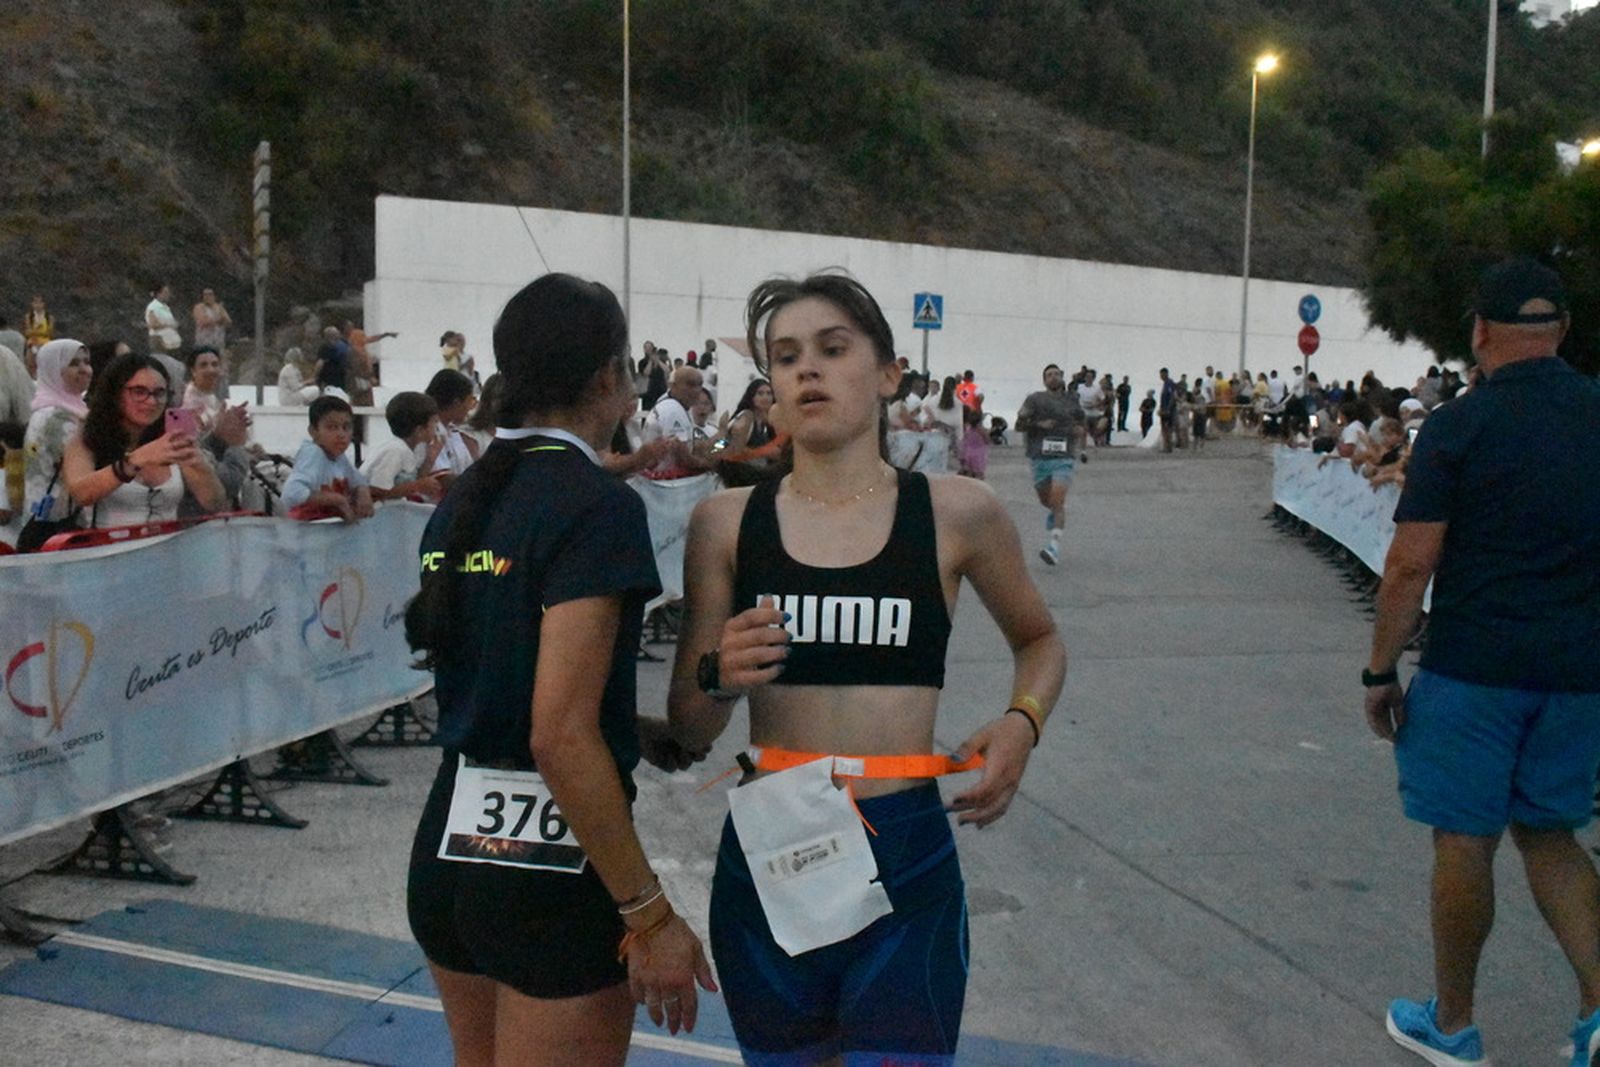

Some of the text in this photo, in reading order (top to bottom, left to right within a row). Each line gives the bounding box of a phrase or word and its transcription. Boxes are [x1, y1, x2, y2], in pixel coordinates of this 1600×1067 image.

[125, 606, 277, 700] Ceuta es Deporte
[476, 791, 569, 842] 376
